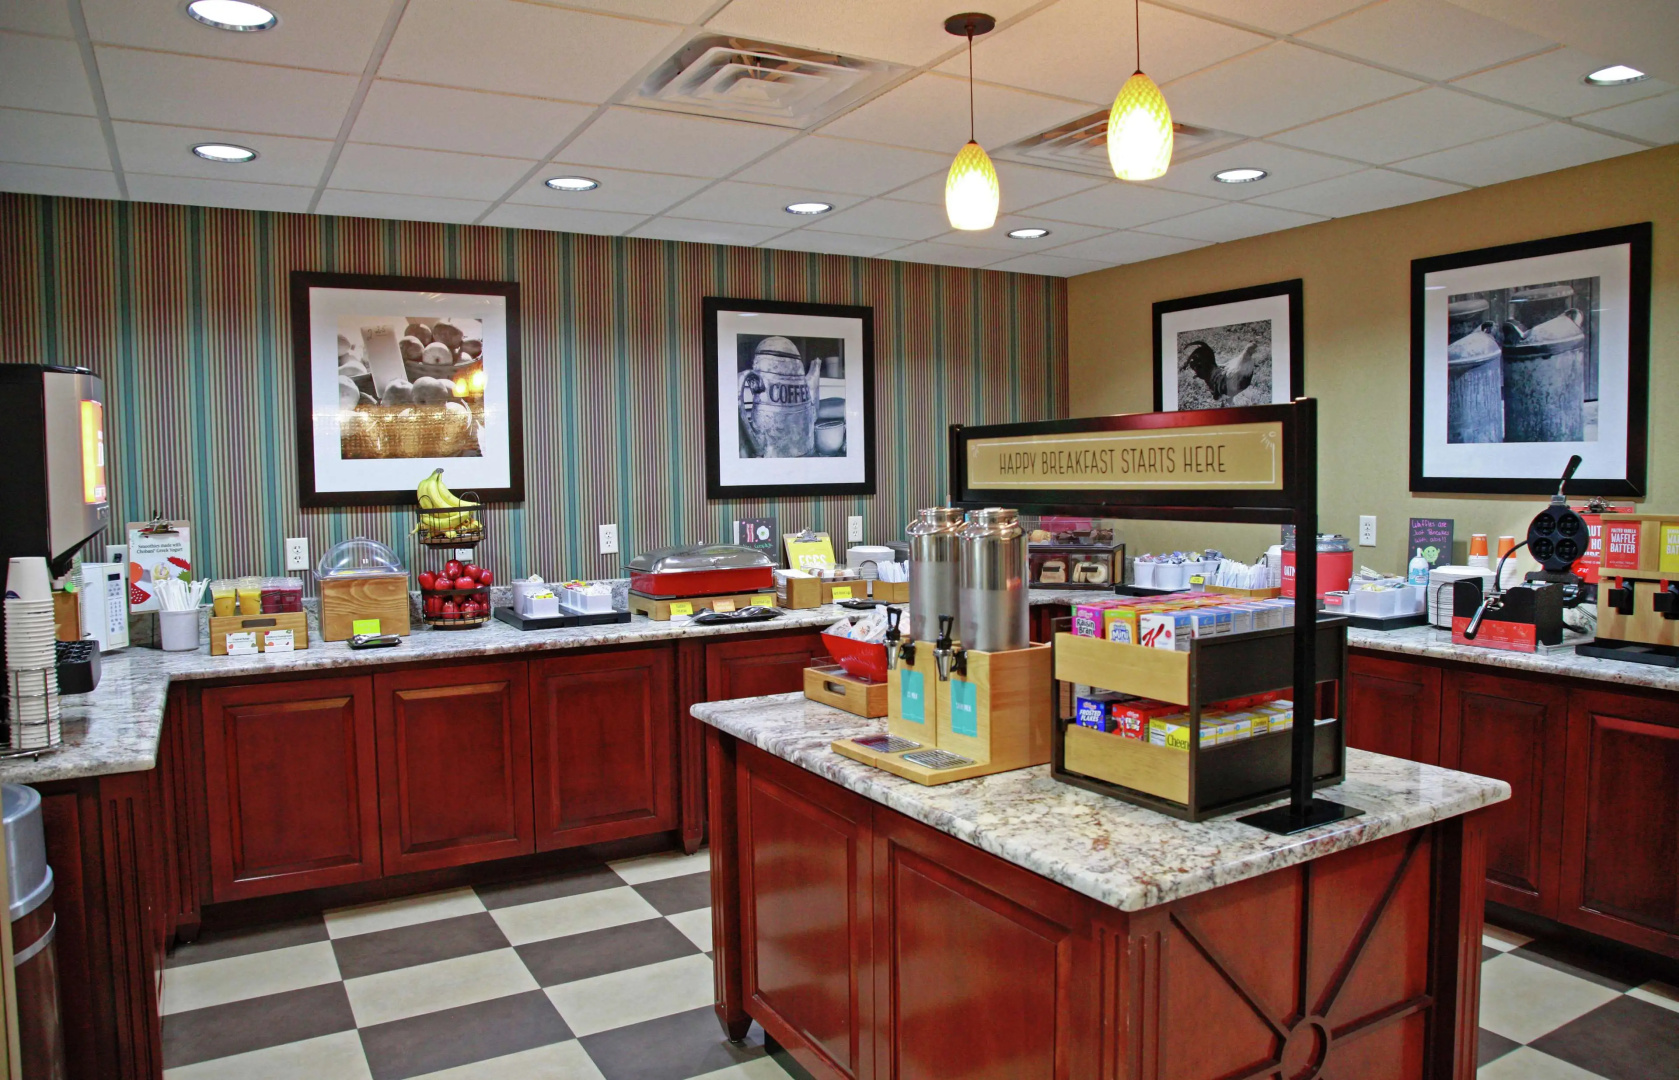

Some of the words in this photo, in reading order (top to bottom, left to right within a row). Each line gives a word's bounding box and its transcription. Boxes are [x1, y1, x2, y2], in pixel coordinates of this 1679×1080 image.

[768, 383, 810, 403] COFFEE
[999, 452, 1037, 476] HAPPY
[1041, 449, 1115, 475] BREAKFAST
[1121, 447, 1176, 474] STARTS
[1183, 445, 1227, 473] HERE
[1610, 533, 1637, 544] WAFFLE
[1610, 543, 1636, 554] BATTER
[1076, 618, 1095, 629] Raisin
[1078, 627, 1093, 635] Bran
[1079, 709, 1102, 717] FROSTED
[1080, 714, 1100, 722] FLAKES
